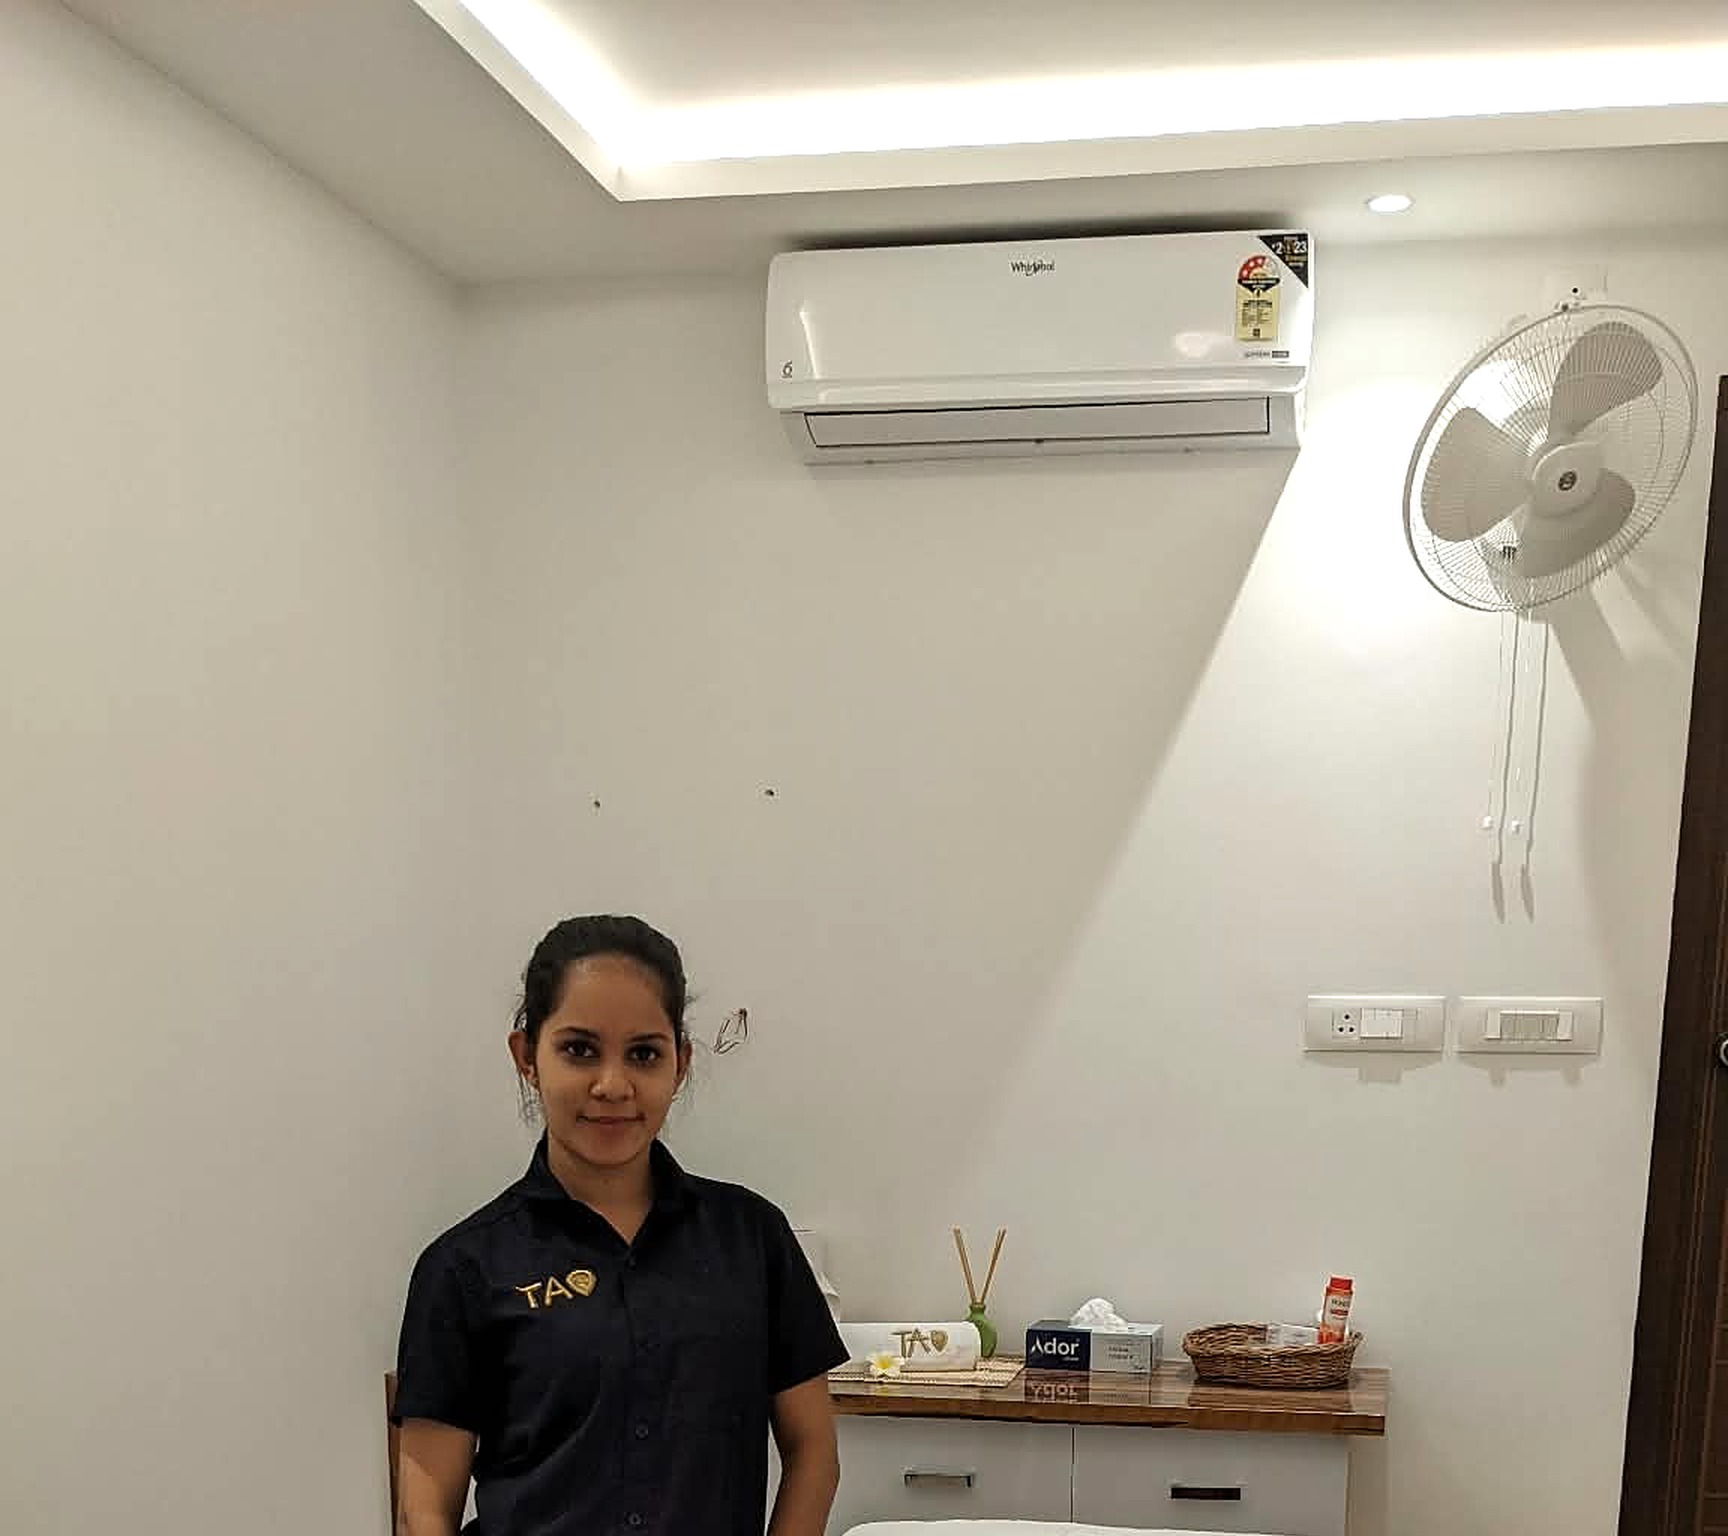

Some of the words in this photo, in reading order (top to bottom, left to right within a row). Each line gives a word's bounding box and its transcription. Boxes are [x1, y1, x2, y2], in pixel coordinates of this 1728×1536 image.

[515, 1269, 598, 1309] TAO
[891, 1328, 949, 1358] TAO
[1031, 1335, 1080, 1356] Ador
